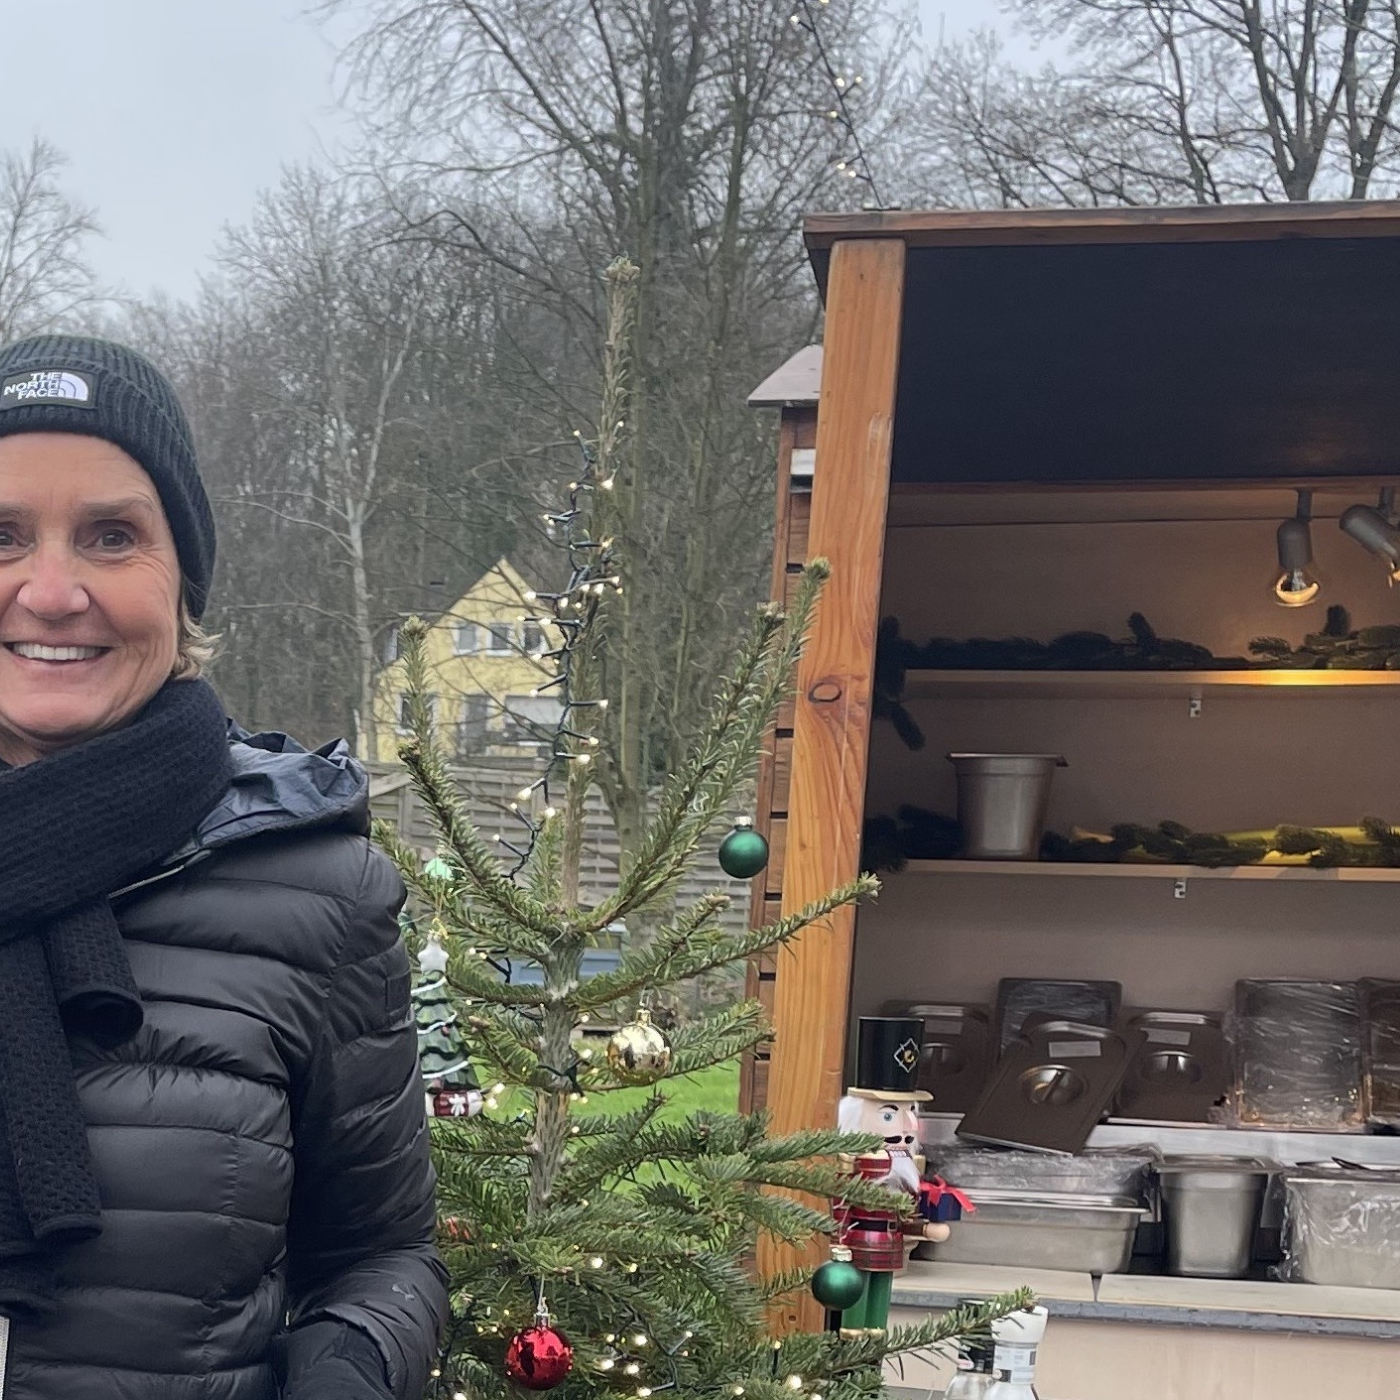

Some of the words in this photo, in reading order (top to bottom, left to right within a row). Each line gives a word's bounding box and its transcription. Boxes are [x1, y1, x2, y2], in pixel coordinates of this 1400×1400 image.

[30, 372, 61, 381] THE
[3, 381, 59, 395] NORTH
[17, 389, 58, 400] FACE
